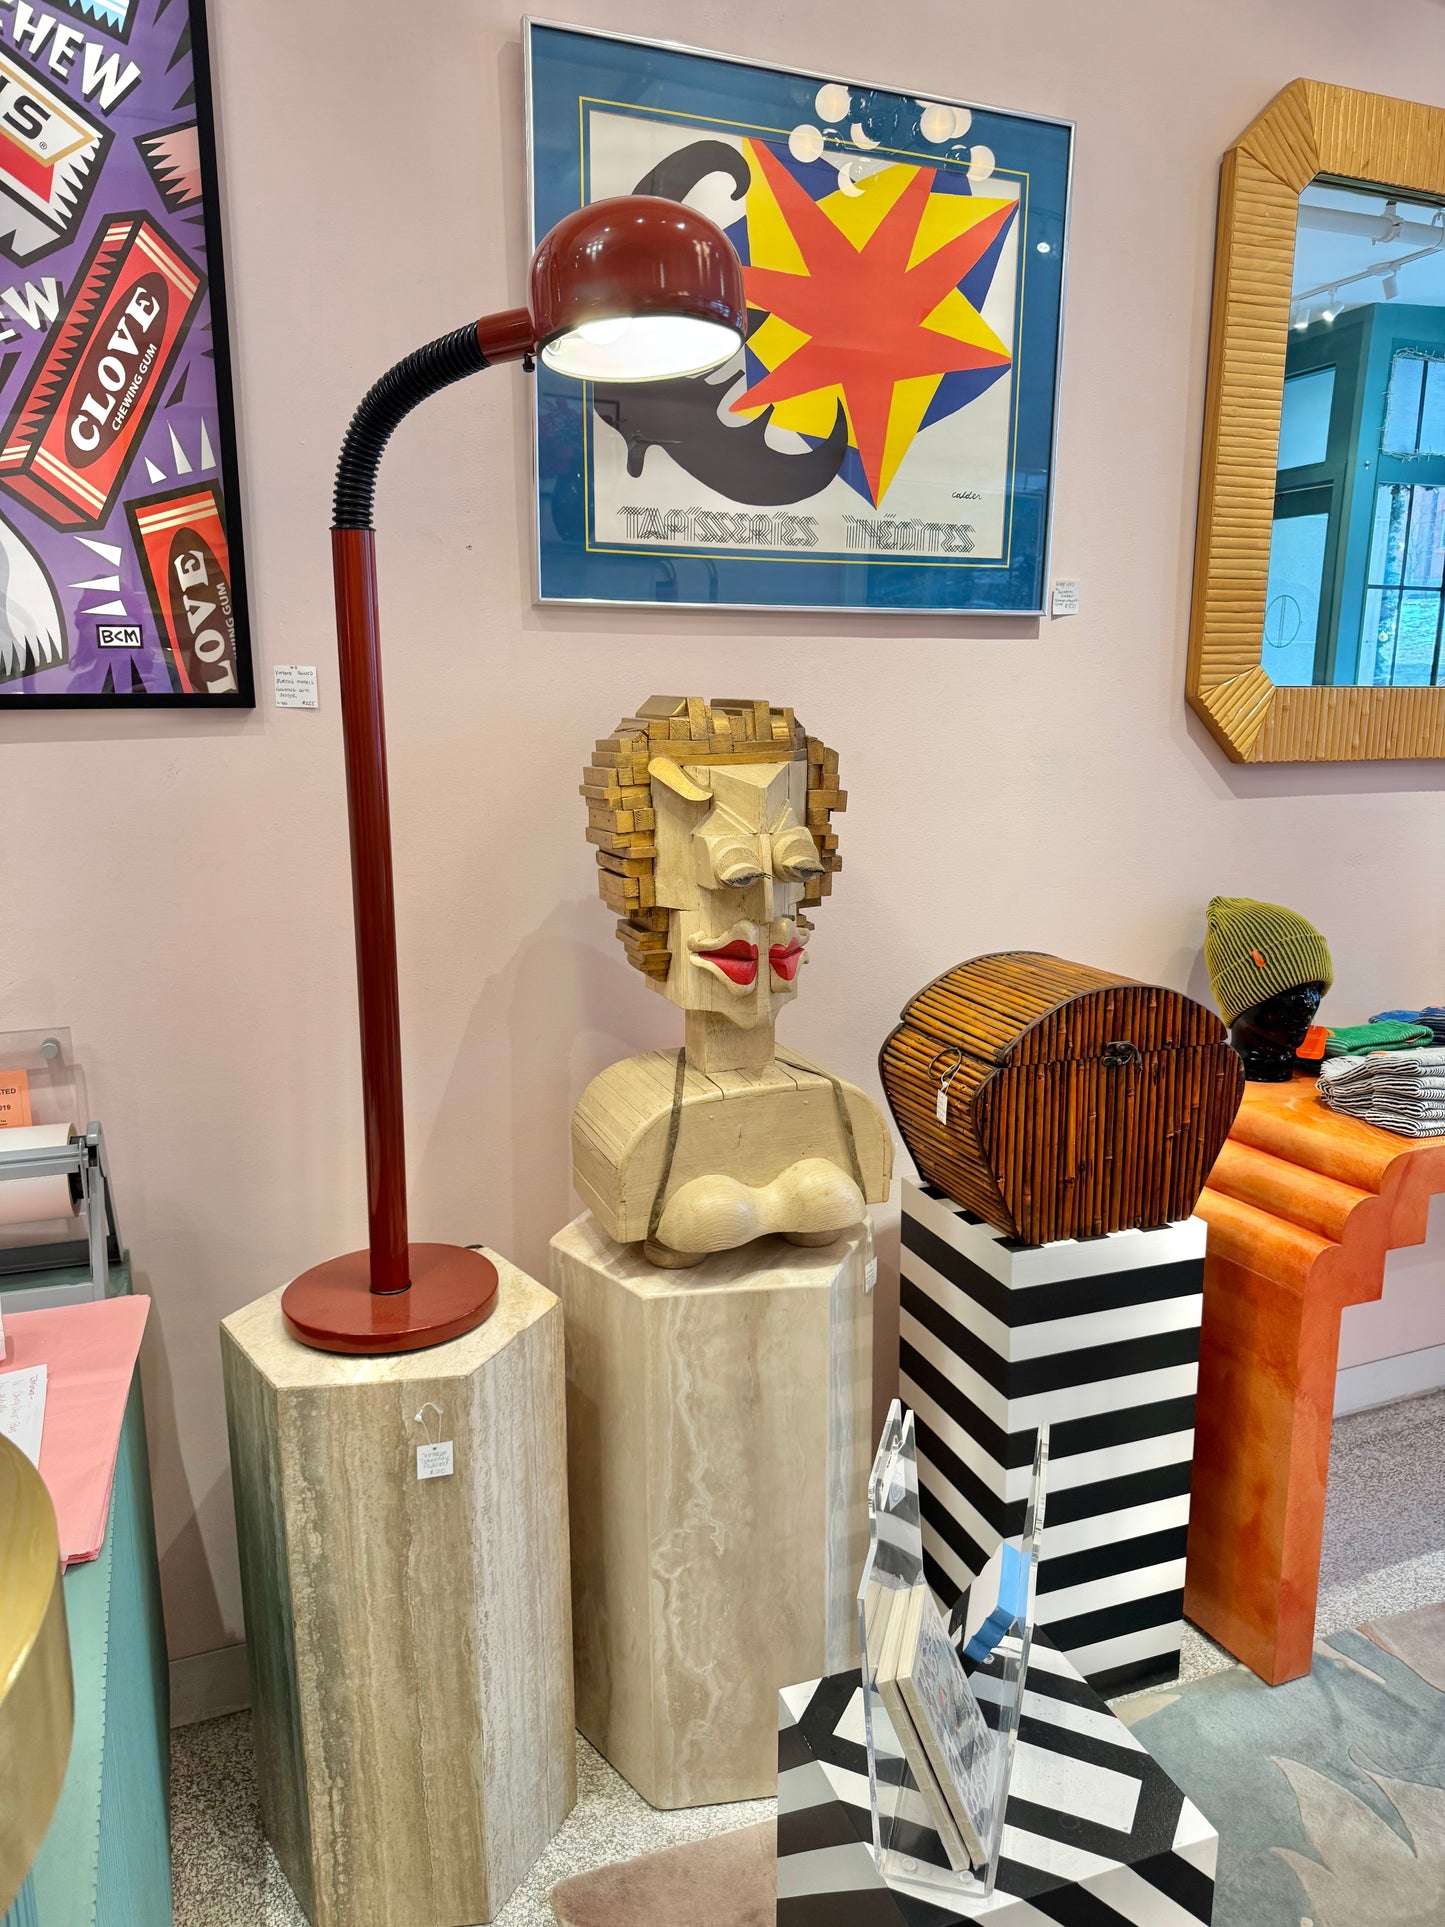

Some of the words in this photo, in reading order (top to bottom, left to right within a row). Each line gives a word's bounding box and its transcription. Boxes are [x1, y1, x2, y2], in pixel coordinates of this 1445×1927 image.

[71, 286, 160, 451] CLOVE
[111, 373, 143, 431] CHEWING
[138, 343, 158, 375] GUM
[216, 582, 232, 616] GUM
[101, 629, 139, 644] BCM
